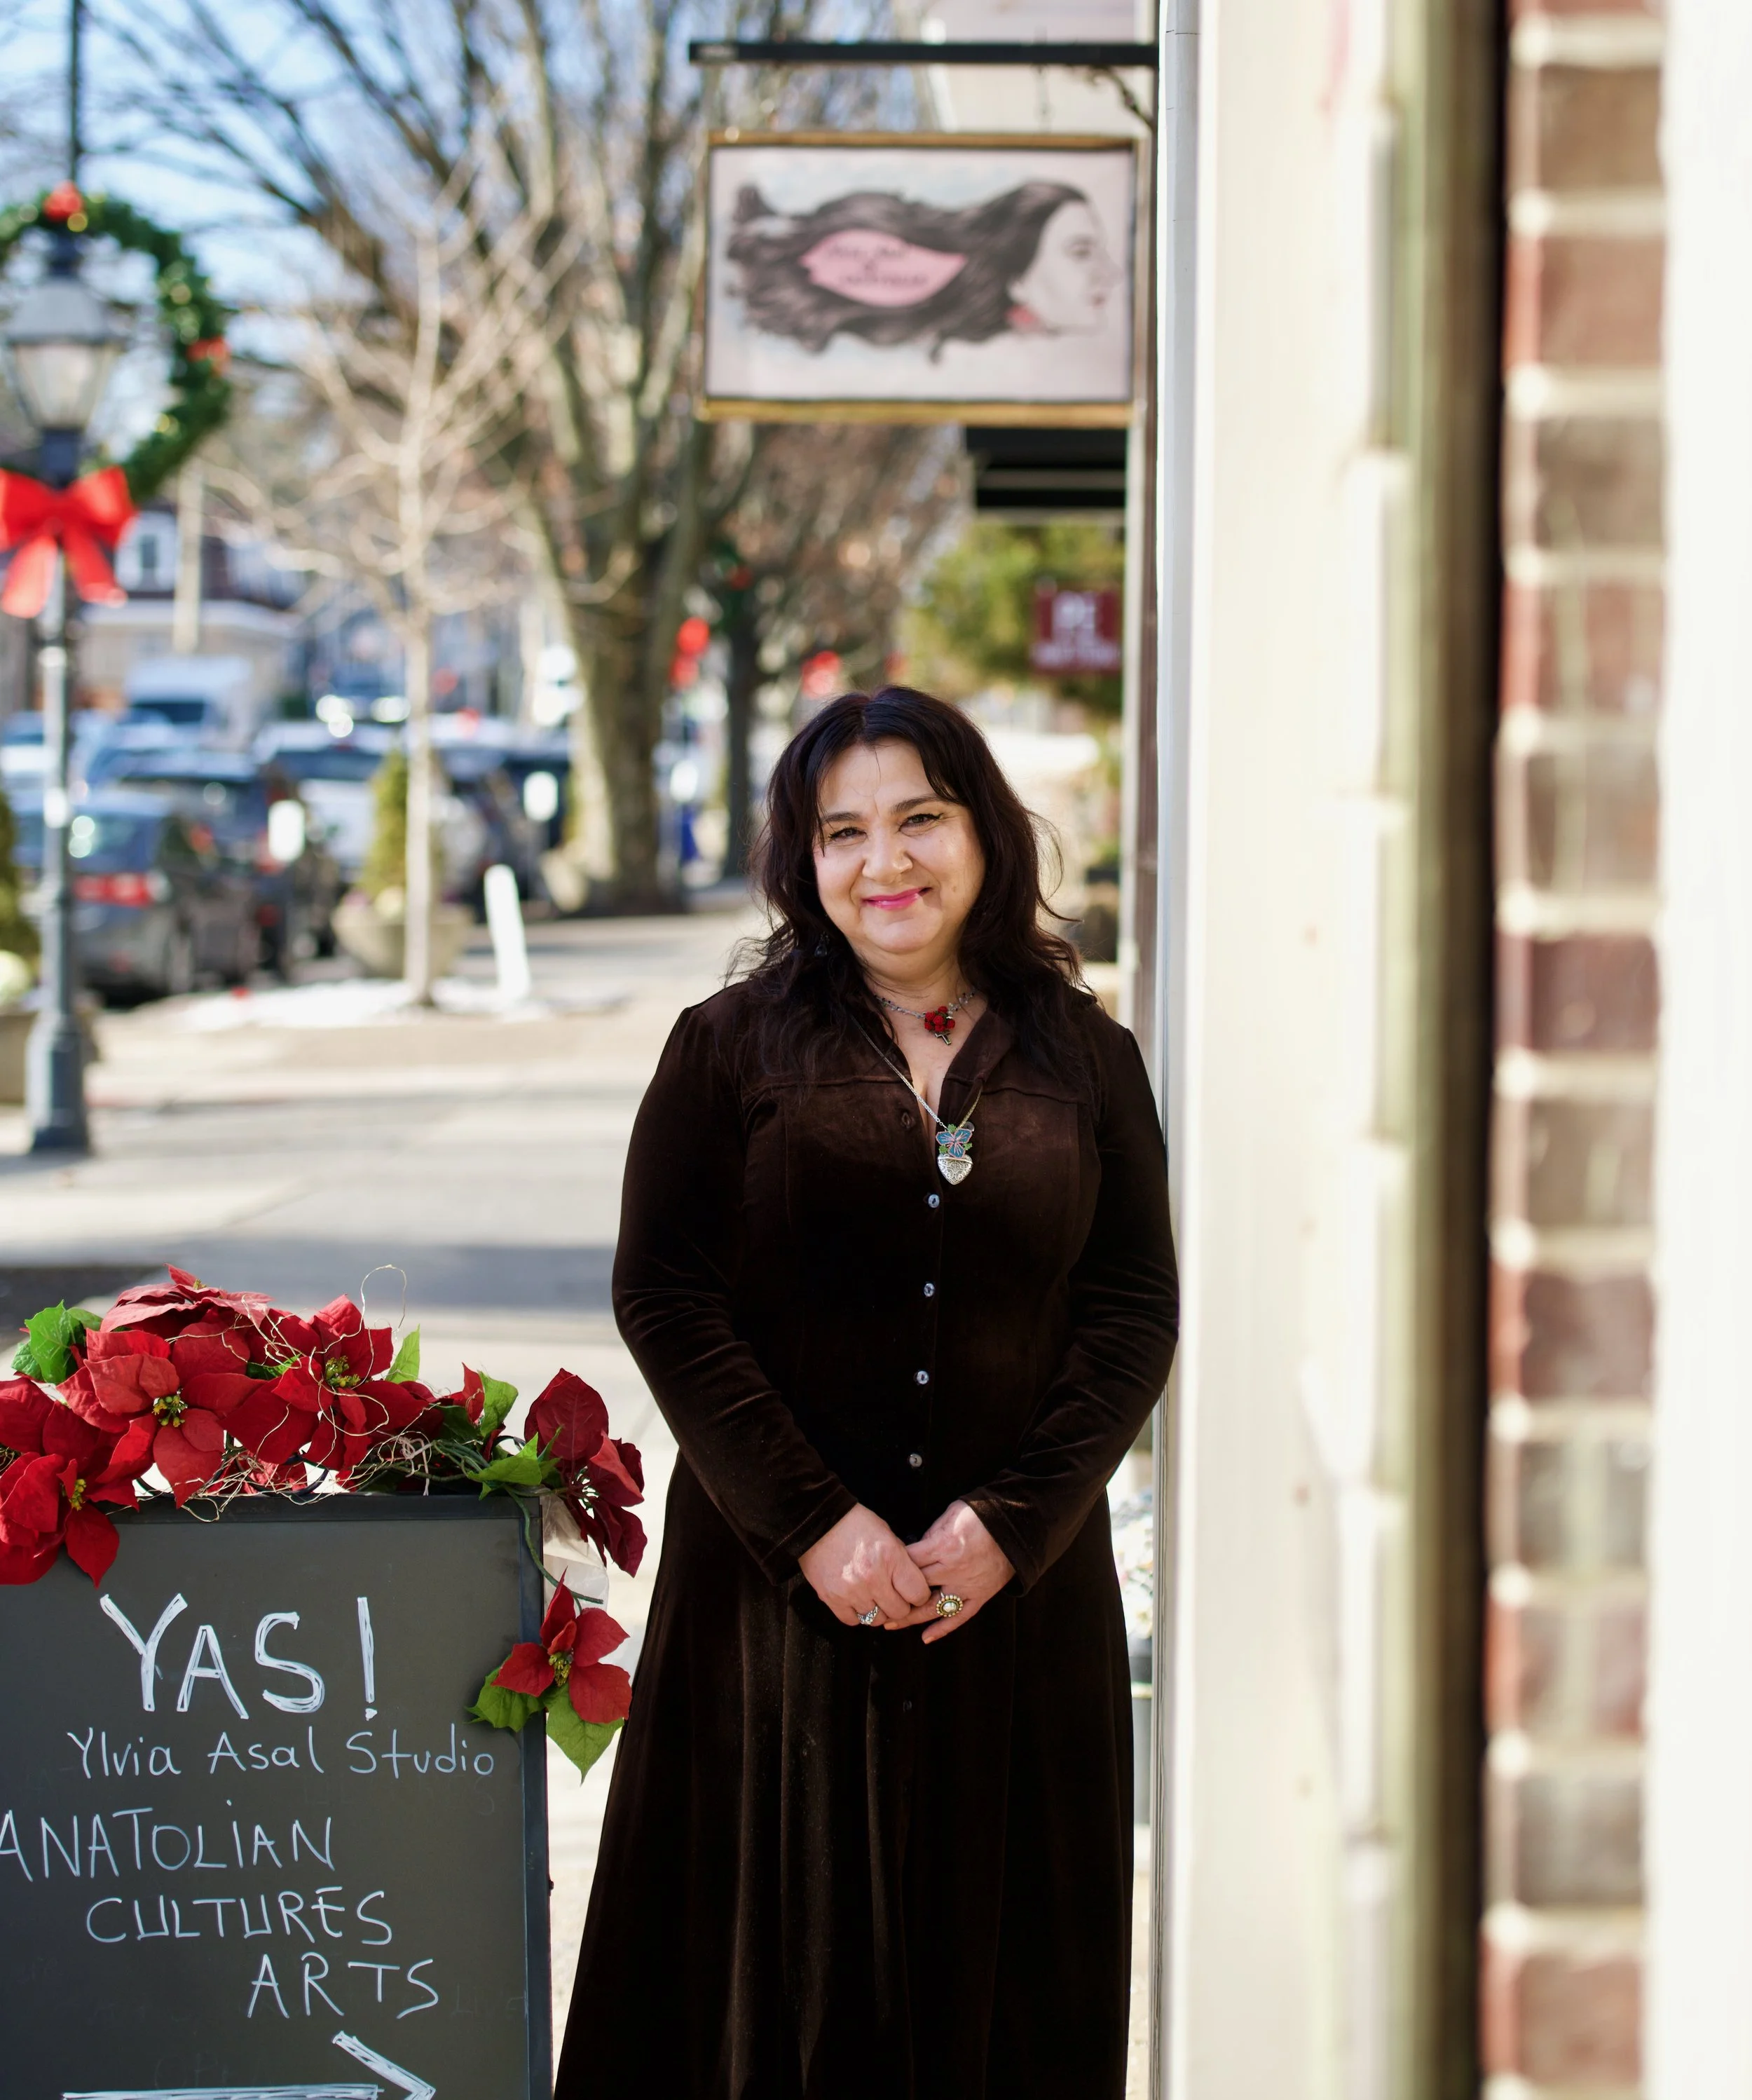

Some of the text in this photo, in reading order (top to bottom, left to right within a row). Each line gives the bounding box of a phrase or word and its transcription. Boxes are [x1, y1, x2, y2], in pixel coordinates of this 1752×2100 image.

[100, 1593, 378, 1721] YAS!
[67, 1723, 494, 1778] Ylvia Asal Studio
[87, 1886, 392, 1946] CULTURES
[247, 1952, 439, 2019] ARTS
